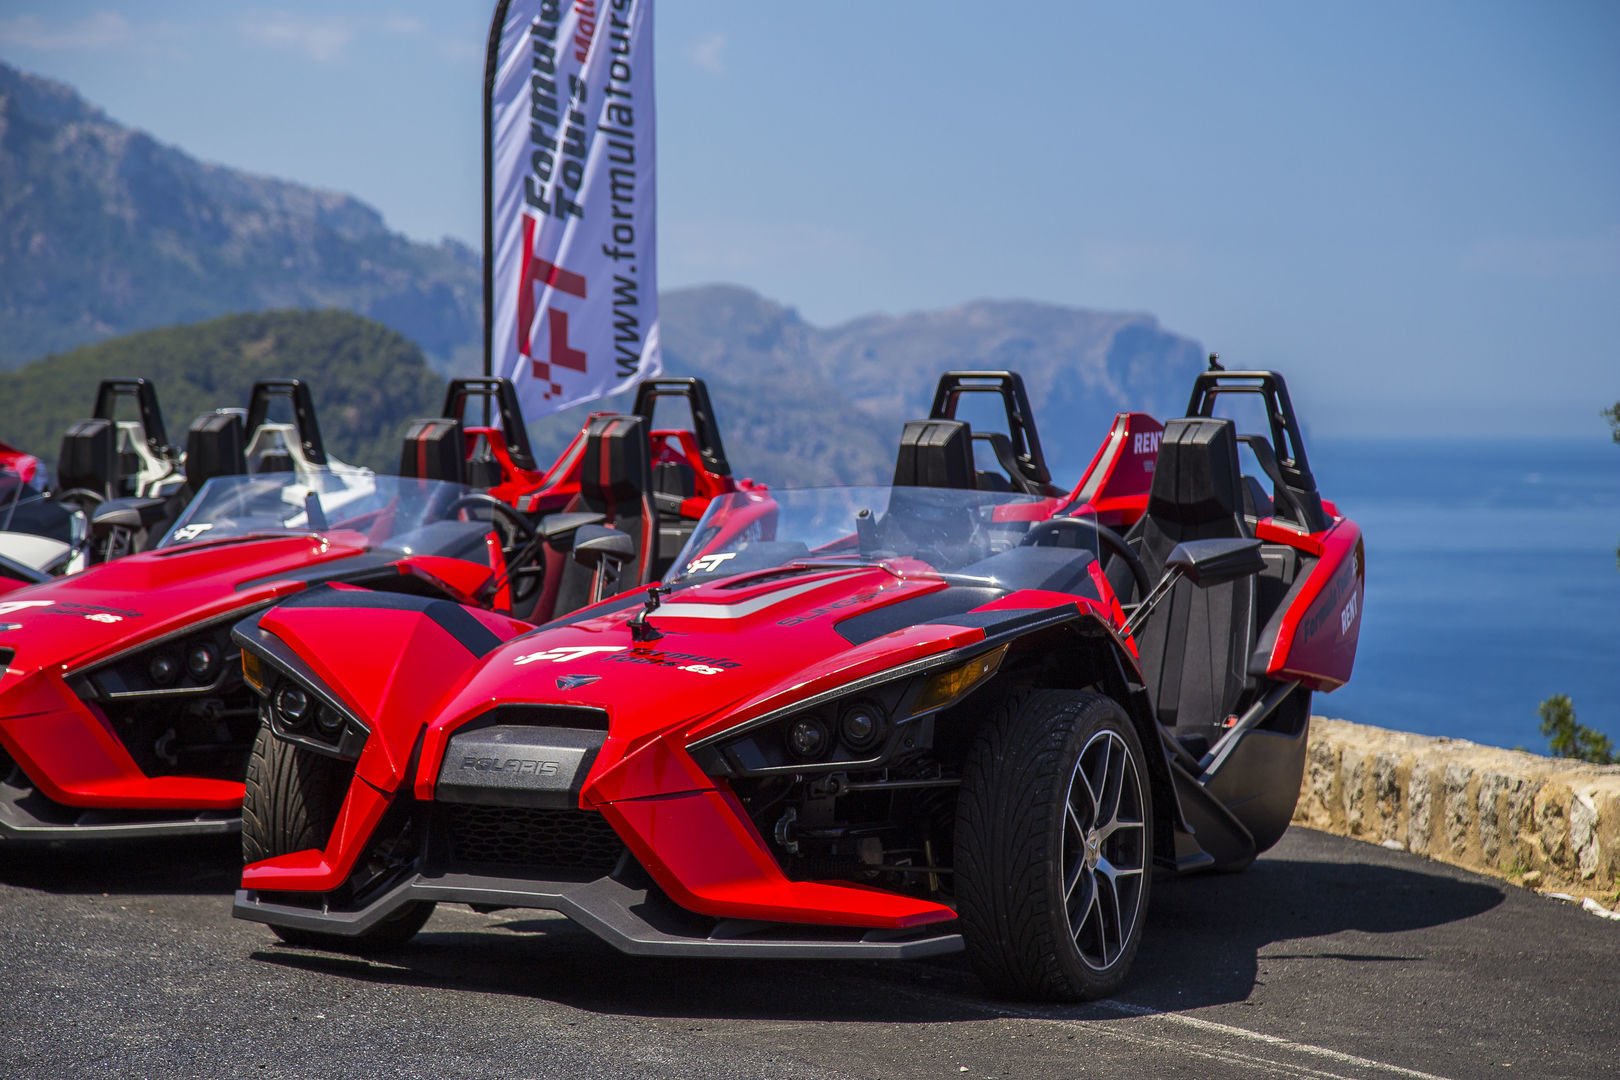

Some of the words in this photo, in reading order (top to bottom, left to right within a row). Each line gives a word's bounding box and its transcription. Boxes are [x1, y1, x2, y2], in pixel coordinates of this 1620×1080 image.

[555, 73, 588, 220] Tours
[517, 213, 587, 382] FT
[686, 552, 737, 574] FT
[1341, 591, 1358, 636] RENT
[513, 646, 628, 665] FT
[460, 756, 560, 777] POLARIS
